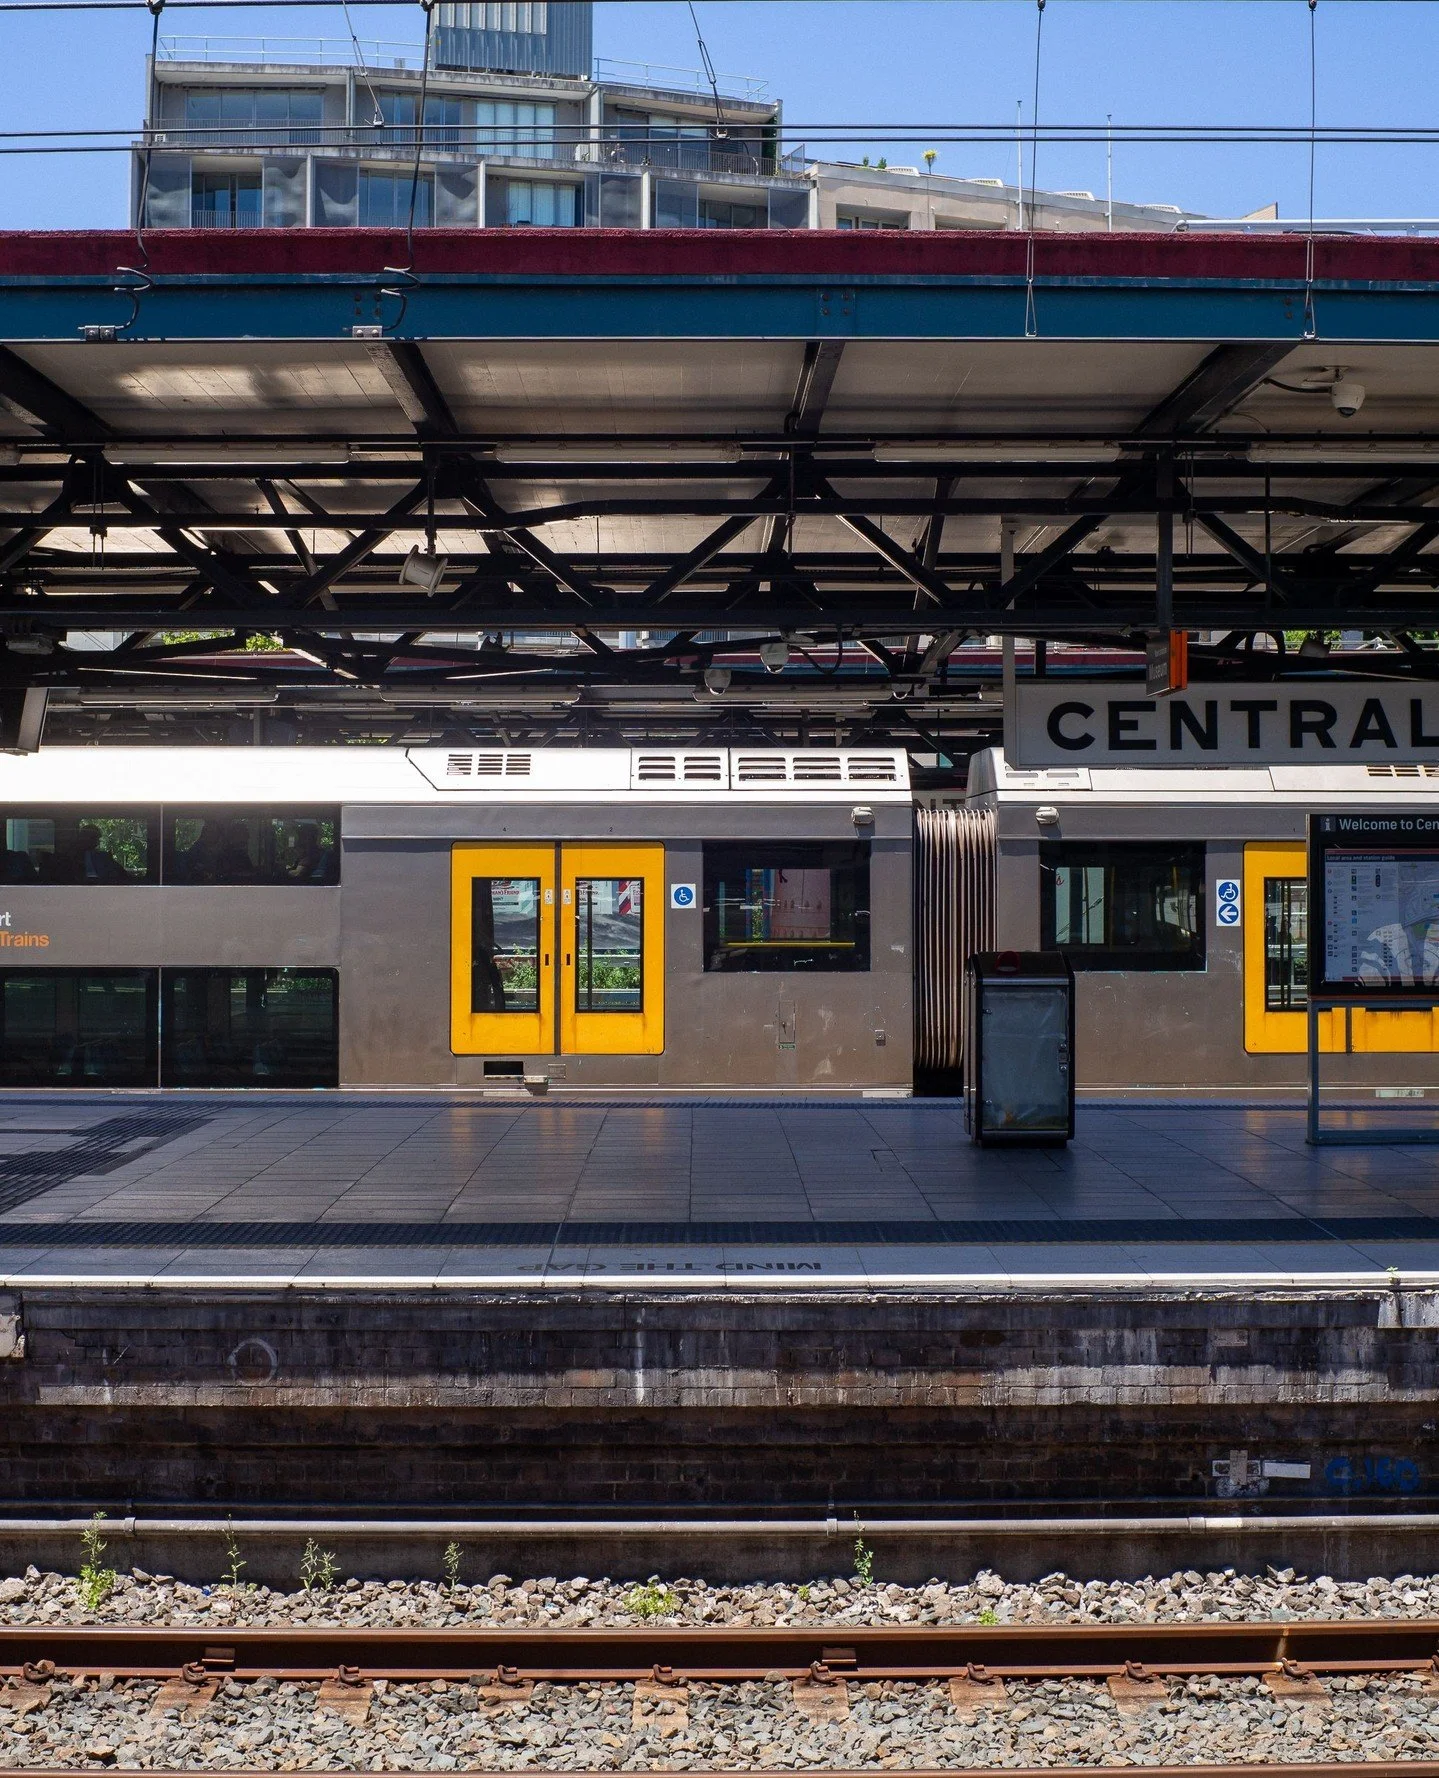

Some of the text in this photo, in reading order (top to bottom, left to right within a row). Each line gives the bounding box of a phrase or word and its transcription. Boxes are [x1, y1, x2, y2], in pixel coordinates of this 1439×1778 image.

[1046, 698, 1439, 750] CENTRAL
[1340, 819, 1398, 830] Welcome
[1400, 820, 1413, 830] to
[0, 931, 50, 947] Trains
[516, 1262, 822, 1270] MIND THE GAP
